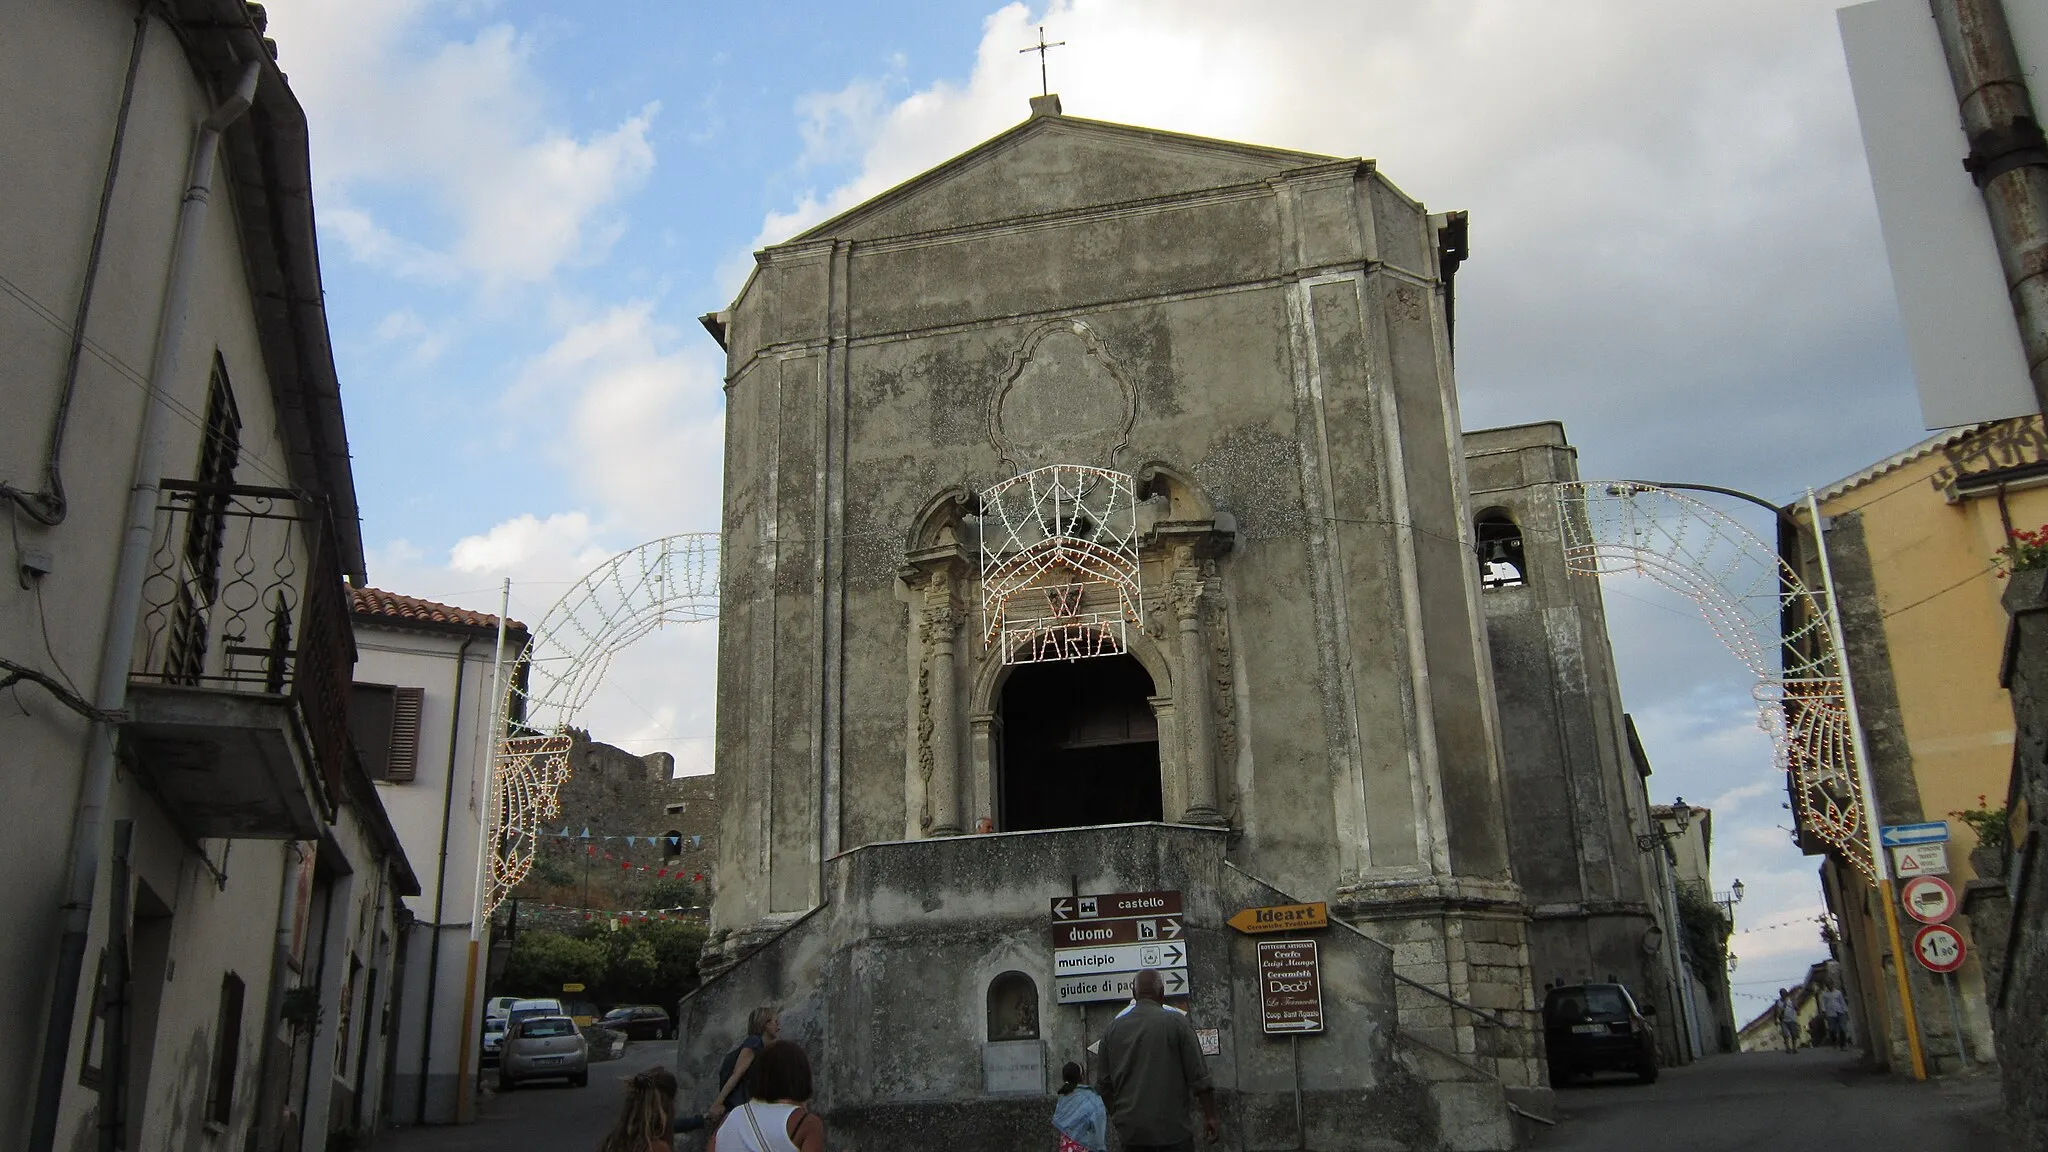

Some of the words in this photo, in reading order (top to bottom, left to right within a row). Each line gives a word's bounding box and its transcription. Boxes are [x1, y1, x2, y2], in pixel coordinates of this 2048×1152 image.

[1041, 583, 1084, 618] W
[1009, 621, 1119, 664] MARIA
[1118, 898, 1164, 911] castello
[1256, 907, 1315, 922] Ideart
[1069, 927, 1114, 943] duomo
[1058, 955, 1115, 970] municipio
[1262, 960, 1284, 968] Luigi
[1060, 982, 1098, 998] giudice
[1102, 981, 1112, 992] di
[1117, 983, 1134, 996] pac
